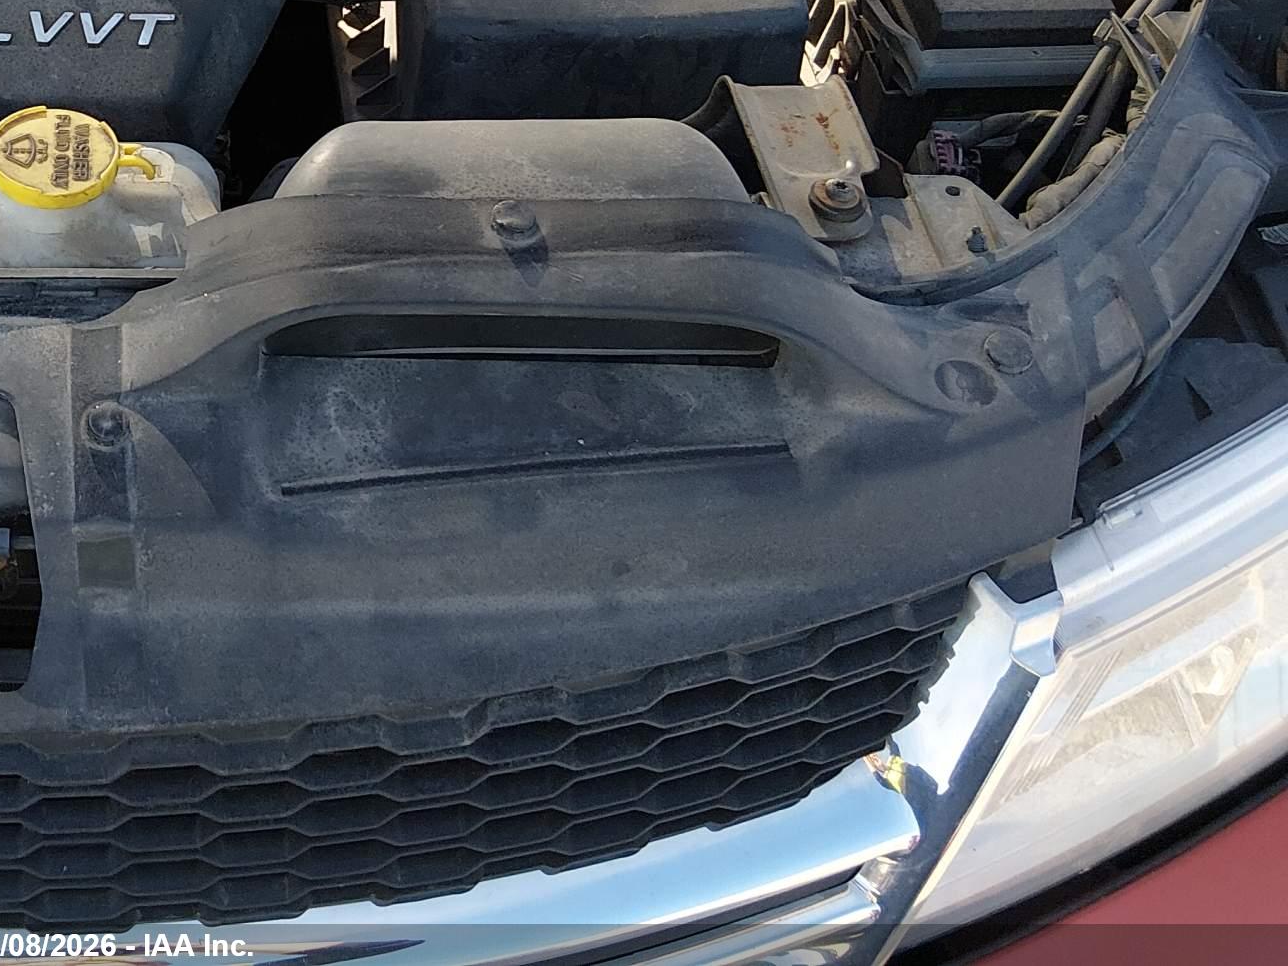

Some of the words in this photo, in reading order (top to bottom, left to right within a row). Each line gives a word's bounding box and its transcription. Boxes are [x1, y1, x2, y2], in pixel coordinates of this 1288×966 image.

[28, 9, 177, 48] VVT
[55, 114, 71, 152] FLUID
[50, 153, 70, 191] ONLY
[72, 123, 90, 183] WASHER
